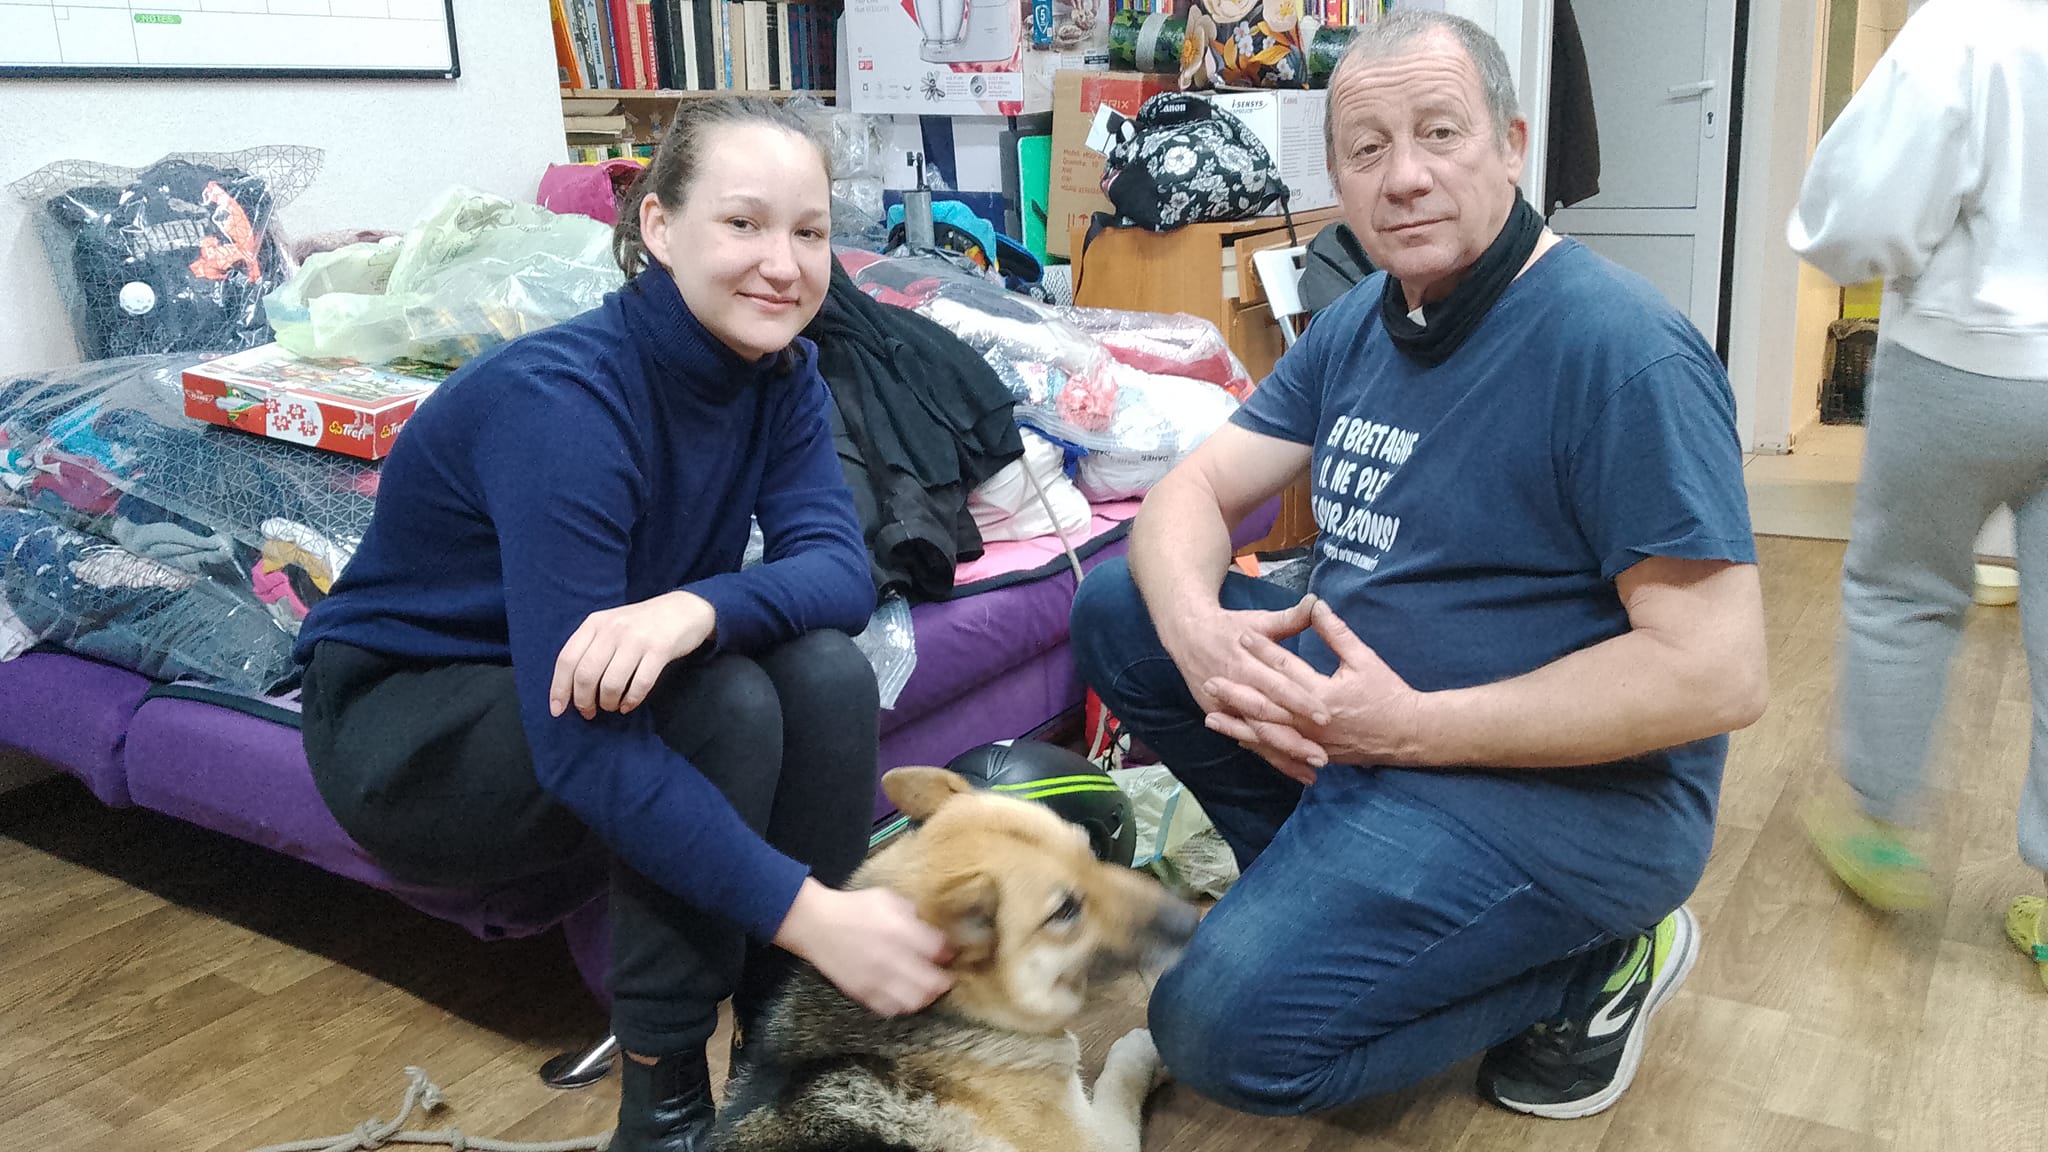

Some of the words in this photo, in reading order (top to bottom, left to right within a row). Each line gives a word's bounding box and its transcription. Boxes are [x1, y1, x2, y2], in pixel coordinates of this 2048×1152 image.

[1040, 9, 1046, 21] 5
[1327, 415, 1351, 448] EN
[1344, 418, 1419, 464] BRETAGNE
[1319, 456, 1333, 488] IL
[1331, 460, 1357, 494] NE
